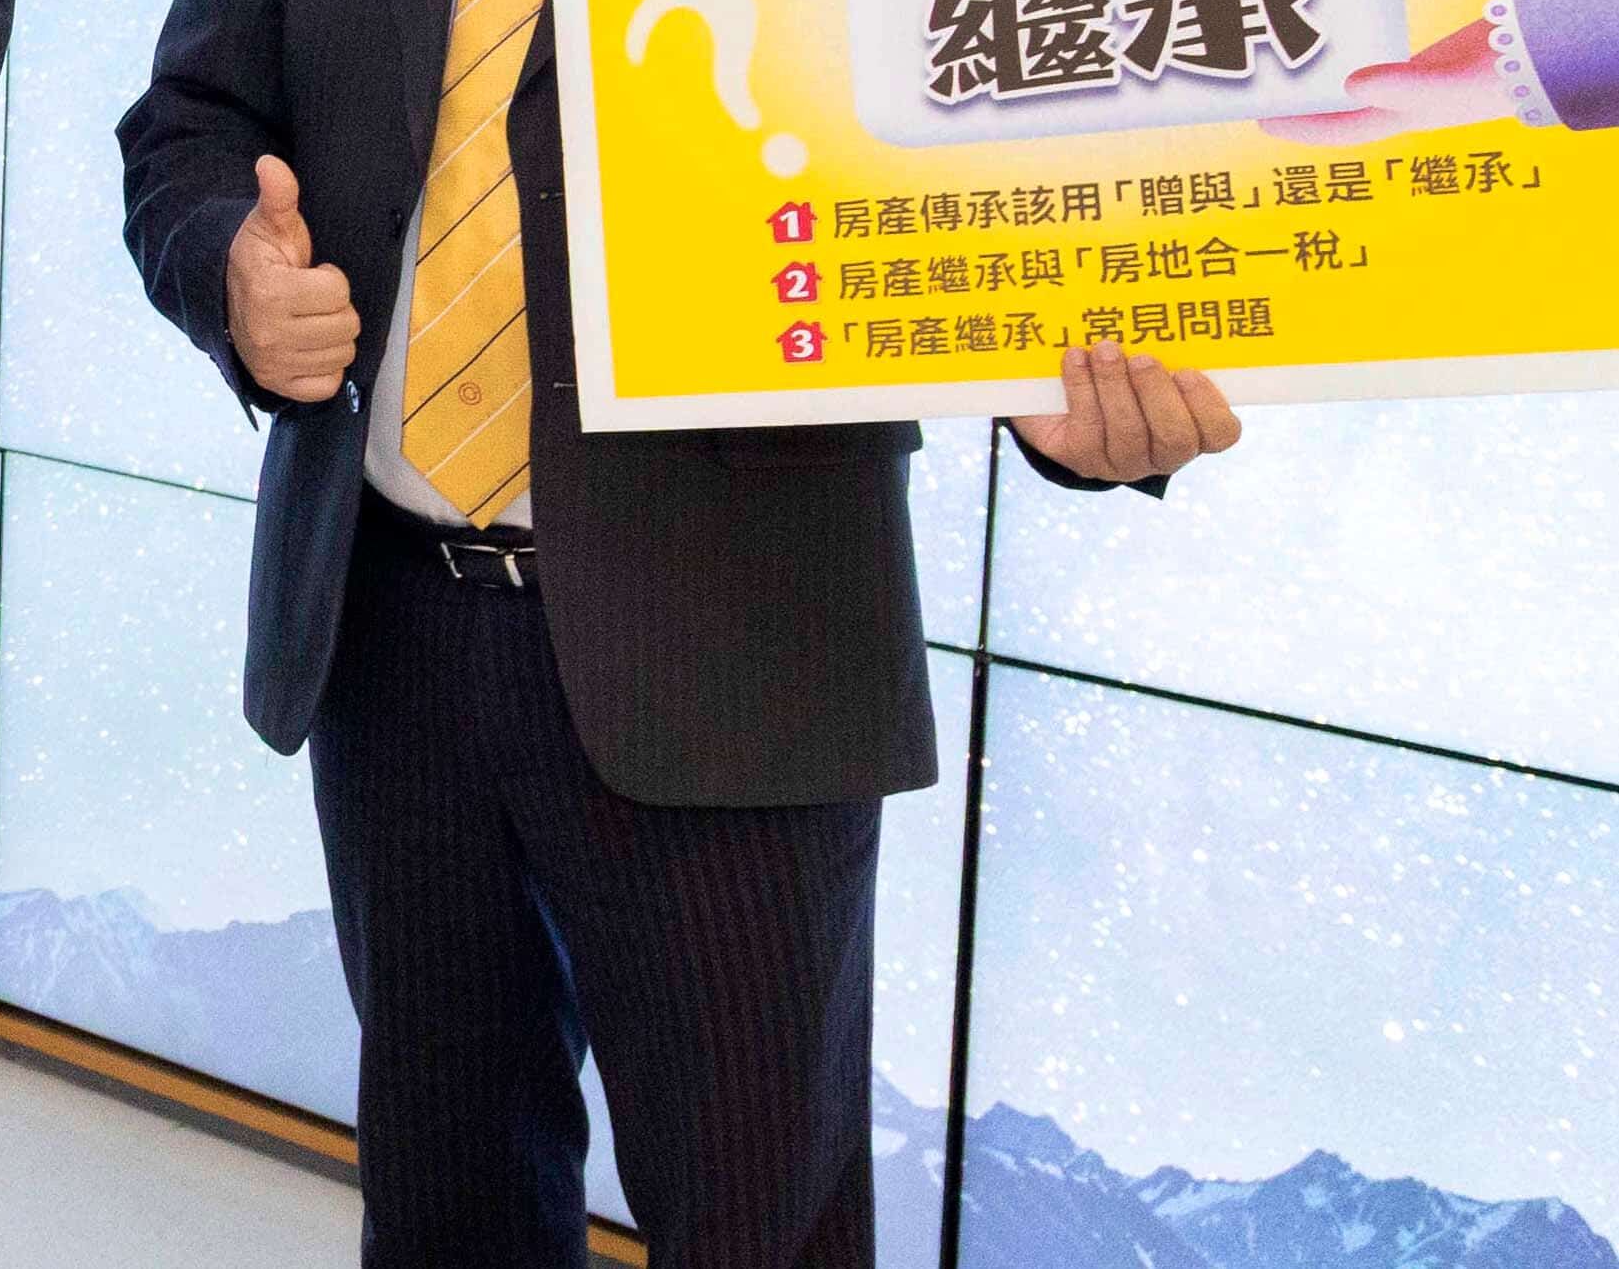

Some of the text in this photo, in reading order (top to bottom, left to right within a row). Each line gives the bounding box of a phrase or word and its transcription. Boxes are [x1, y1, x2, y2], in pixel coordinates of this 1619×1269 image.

[832, 150, 1544, 240] 房產傳承該用「贈與」還是「繼承」
[837, 229, 1369, 301] 房產繼承與「房地合一稅」
[843, 296, 1277, 356] 「房產繼承」常見問題
